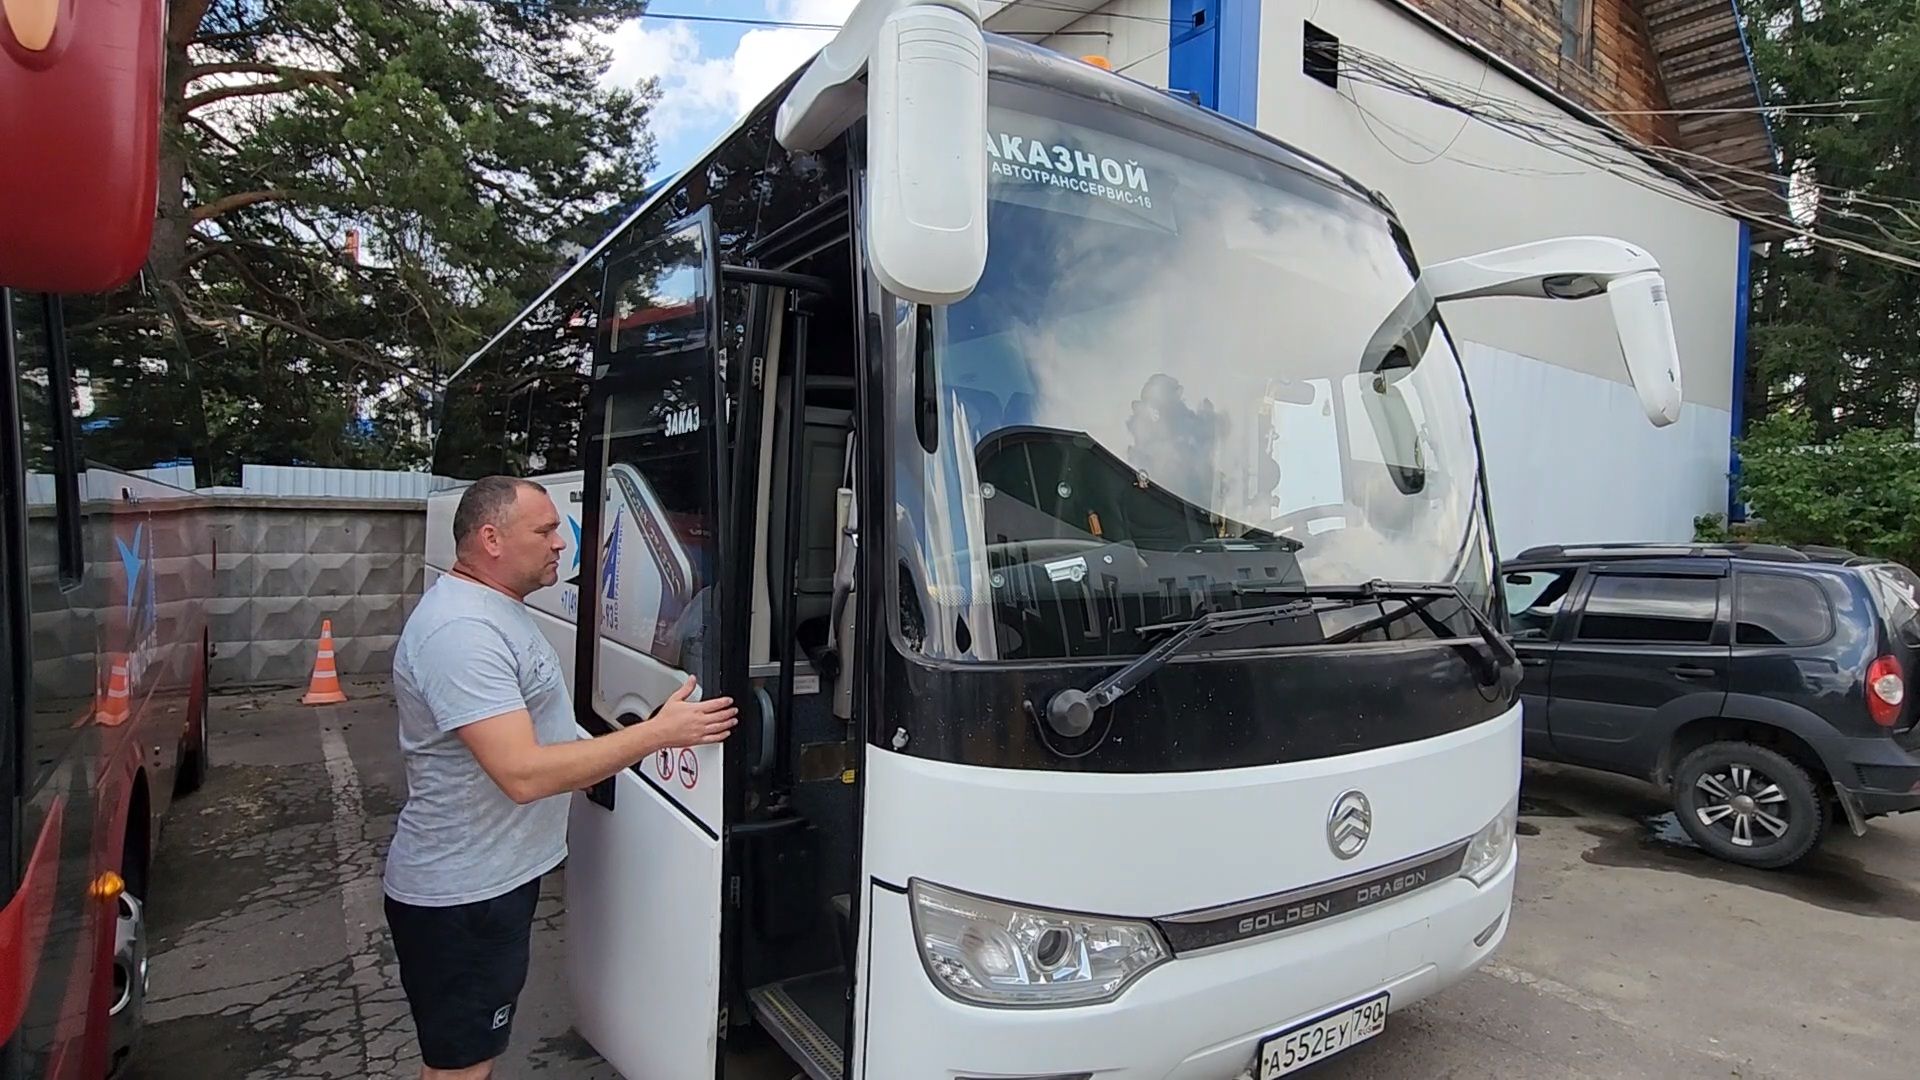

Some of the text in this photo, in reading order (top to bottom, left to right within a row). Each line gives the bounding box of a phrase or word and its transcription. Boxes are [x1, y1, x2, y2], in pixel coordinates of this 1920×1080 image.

[664, 405, 700, 437] ЗАКАЗ
[1238, 869, 1427, 934] GOLDEN DRAGON
